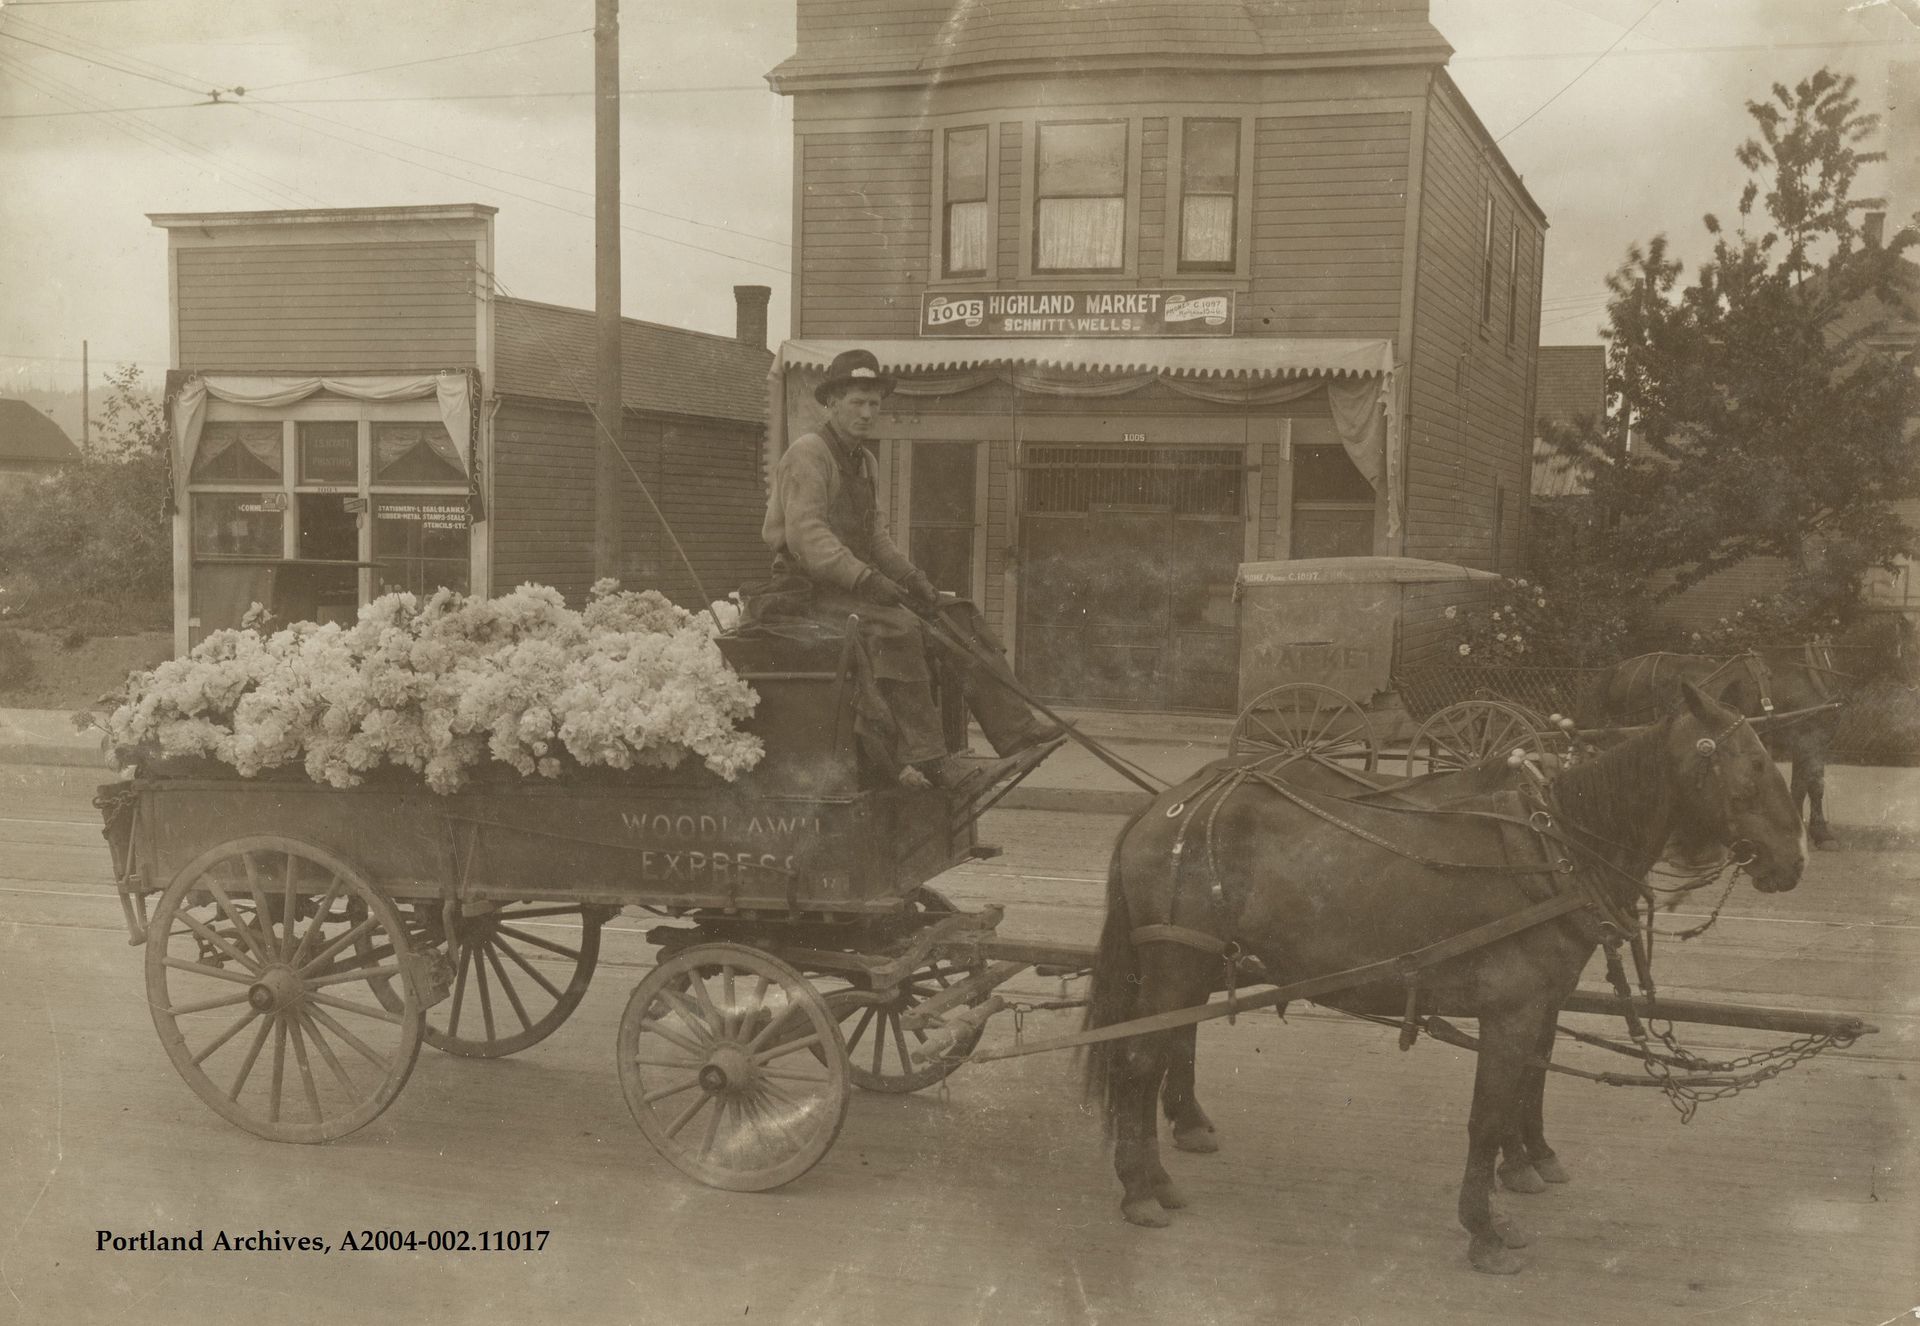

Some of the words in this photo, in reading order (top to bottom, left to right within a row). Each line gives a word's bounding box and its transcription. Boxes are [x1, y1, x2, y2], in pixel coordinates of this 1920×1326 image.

[989, 295, 1075, 314] HIGHLAND
[1086, 294, 1161, 313] MARKET
[932, 303, 981, 321] 1005
[1004, 318, 1065, 331] SCHMITT
[1123, 433, 1146, 442] 1005
